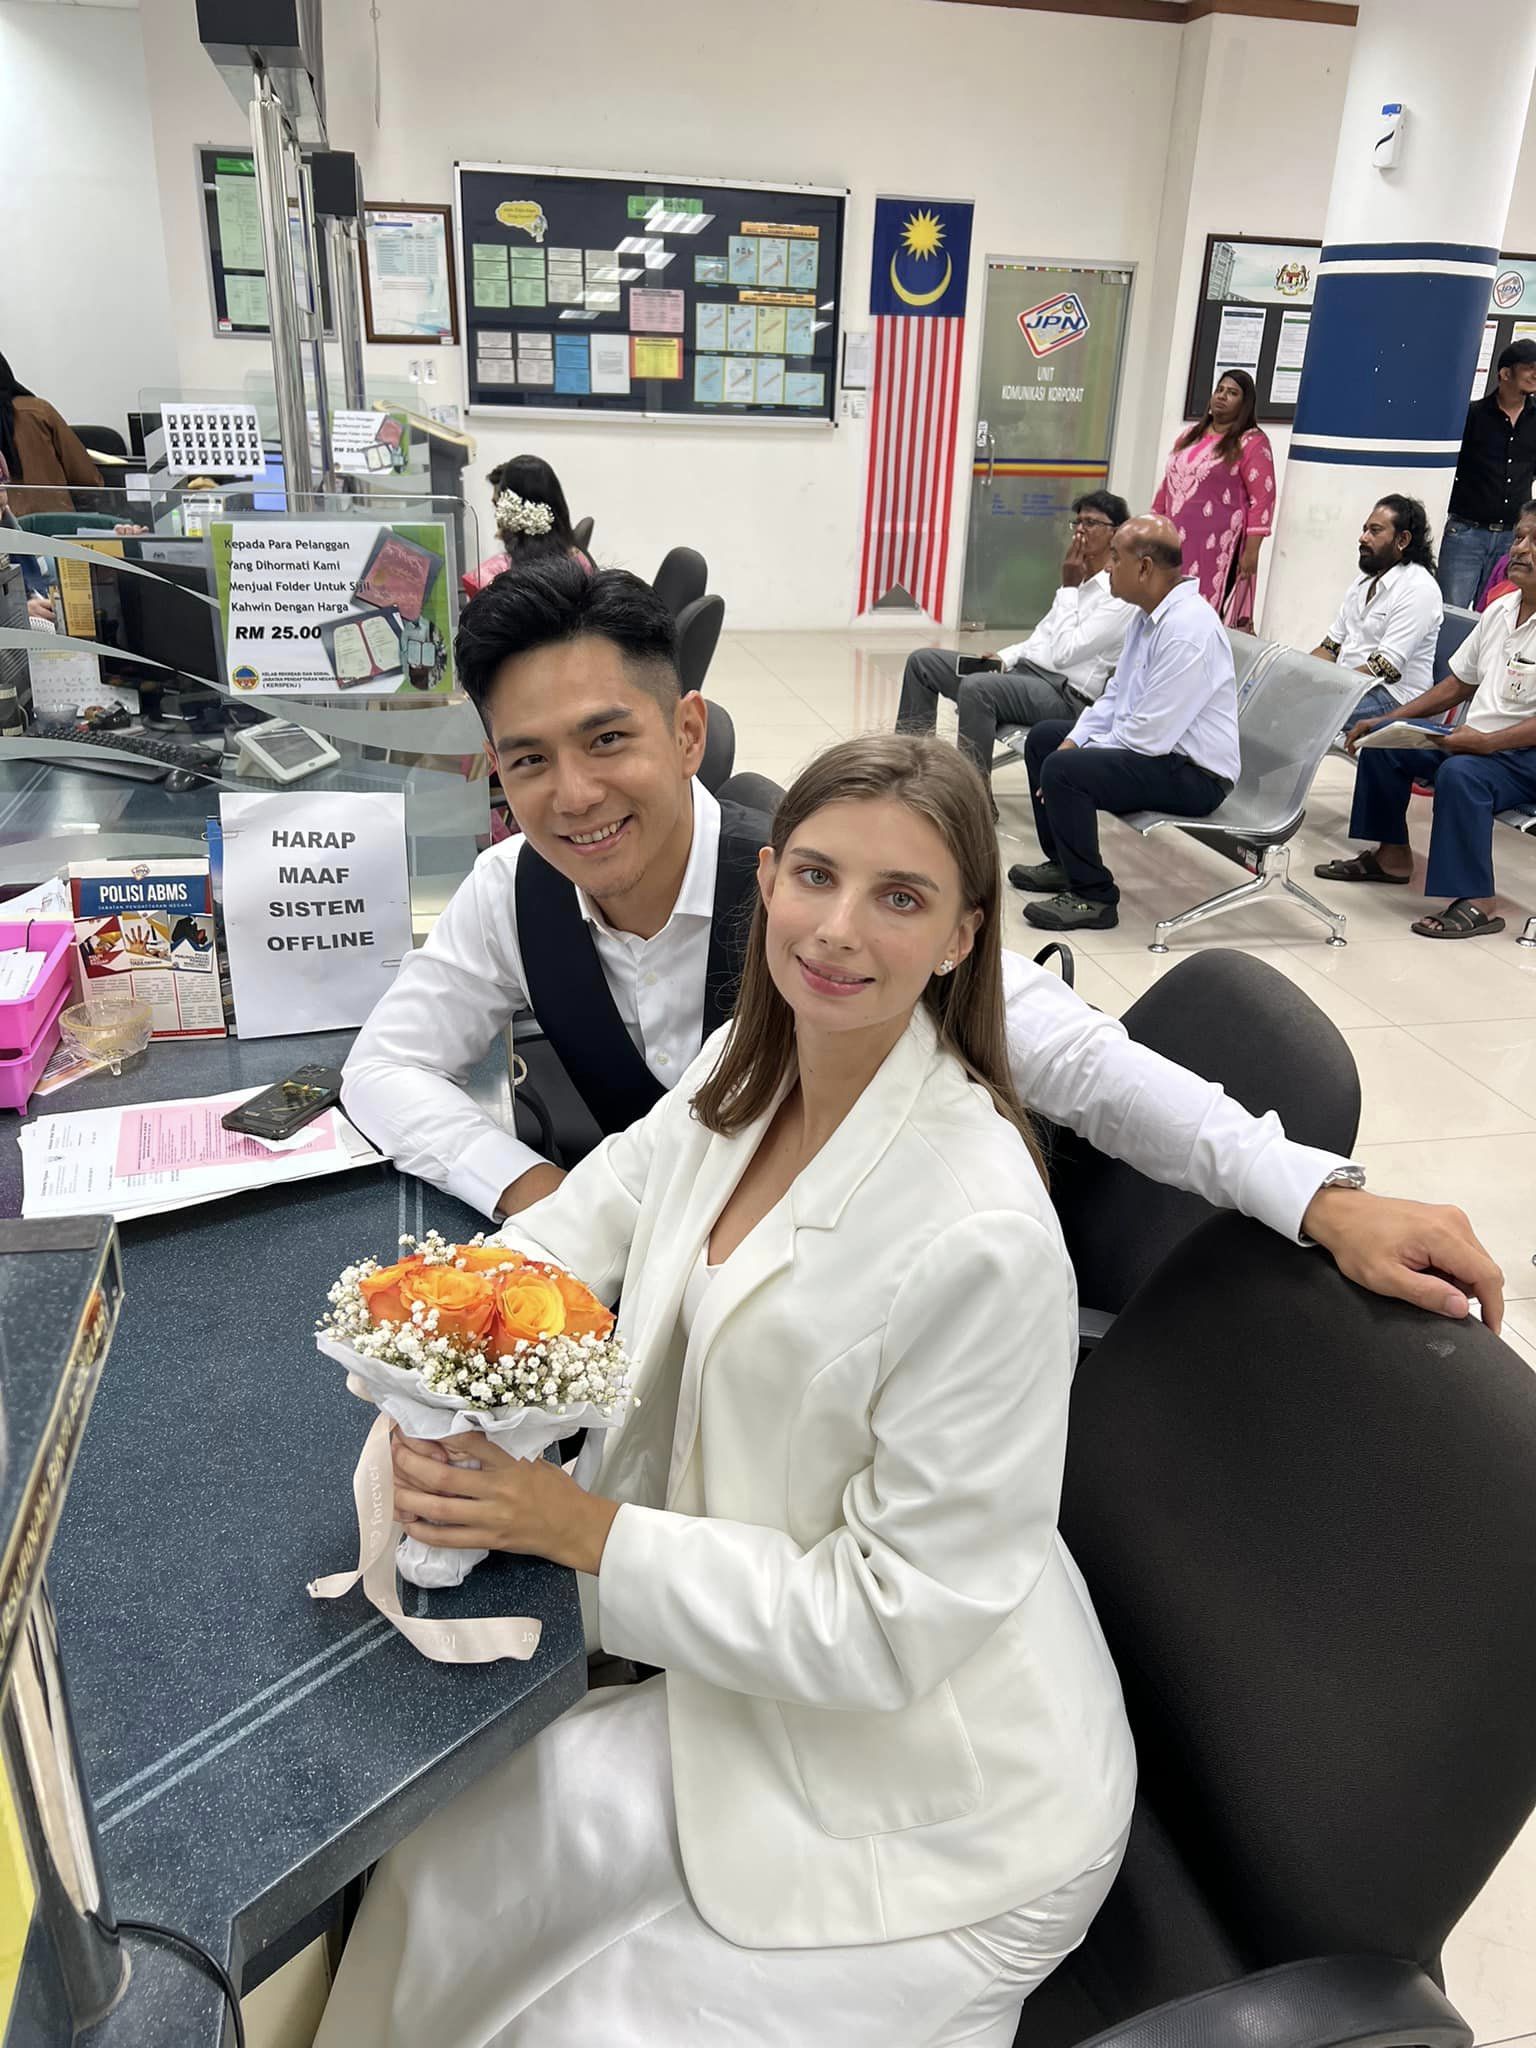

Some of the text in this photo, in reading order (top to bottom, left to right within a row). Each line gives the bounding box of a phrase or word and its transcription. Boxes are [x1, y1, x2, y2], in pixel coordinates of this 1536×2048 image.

[1502, 285, 1520, 293] JPN
[1026, 315, 1082, 330] JPN
[1037, 366, 1055, 381] UNIT
[1001, 385, 1084, 402] KOMUNIKASI KORPORAT
[224, 540, 350, 551] Kepada Para Pelanggan
[227, 560, 340, 572] Yang Dihormati Kami
[229, 581, 370, 593] Menjual Folder Untuk Sijil
[231, 602, 349, 613] Kahwin Dengan Harga
[235, 626, 322, 640] RM 25.00
[271, 830, 356, 849] HARAP
[279, 866, 350, 884] MAAF
[99, 883, 188, 903] POLISI ABMS
[268, 898, 365, 918] SISTEM
[266, 930, 375, 952] OFFLINE
[369, 1465, 384, 1524] forever
